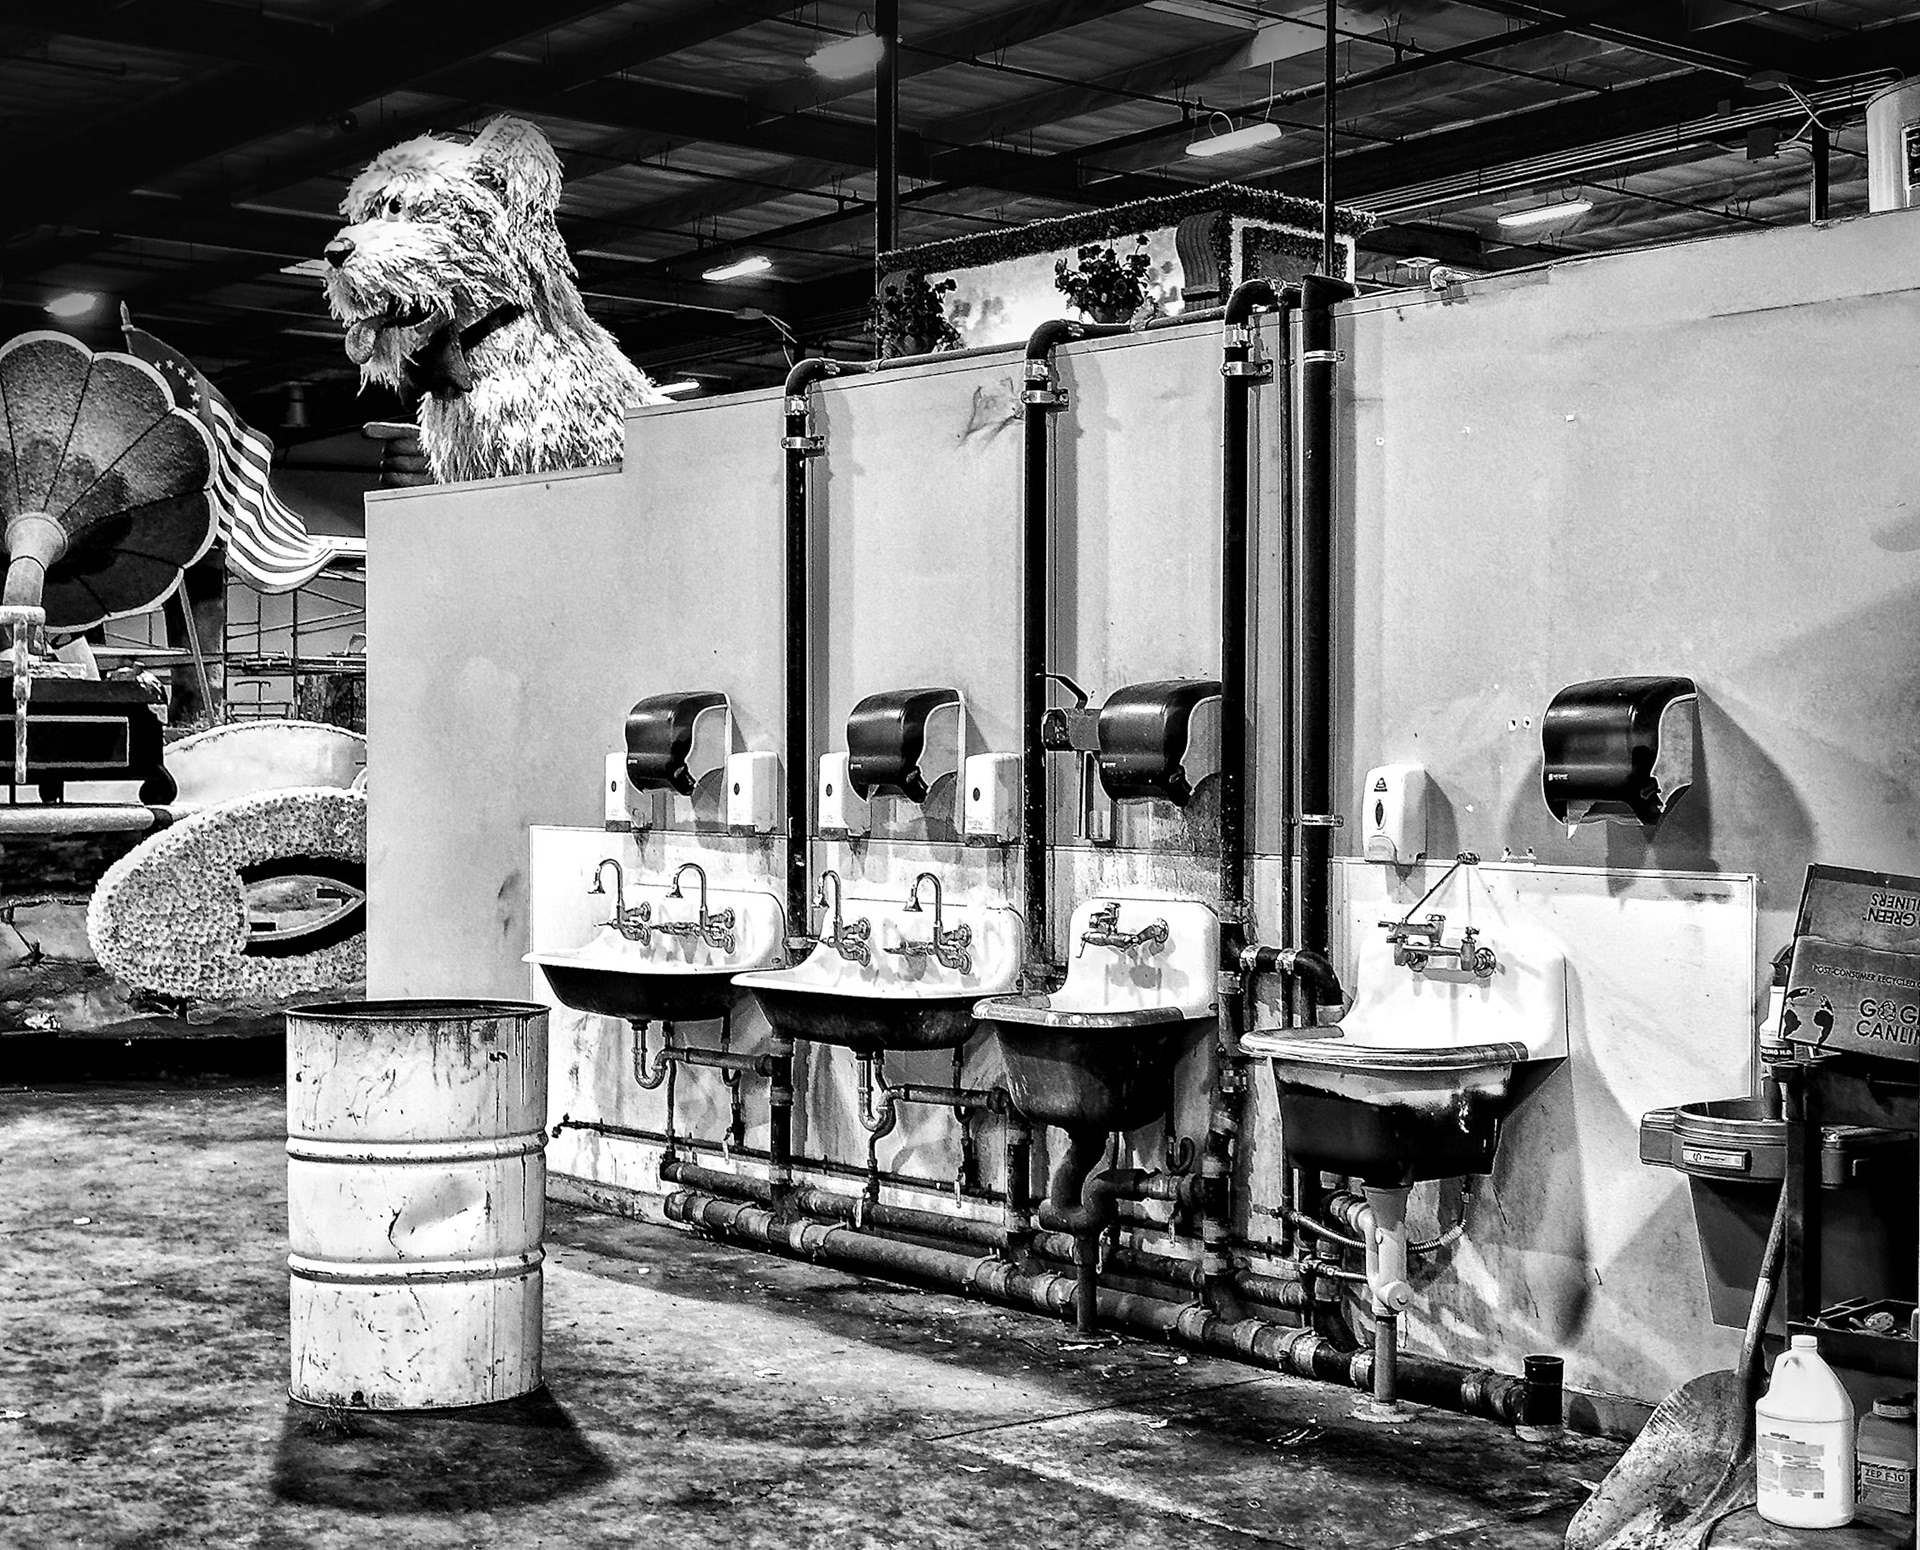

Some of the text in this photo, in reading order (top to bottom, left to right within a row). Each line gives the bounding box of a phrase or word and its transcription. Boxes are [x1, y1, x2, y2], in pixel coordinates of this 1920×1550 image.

[1813, 965, 1876, 982] POST-CONSUMER
[1877, 974, 1916, 988] RECYCLED
[1864, 1467, 1905, 1483] ZEP F-10
